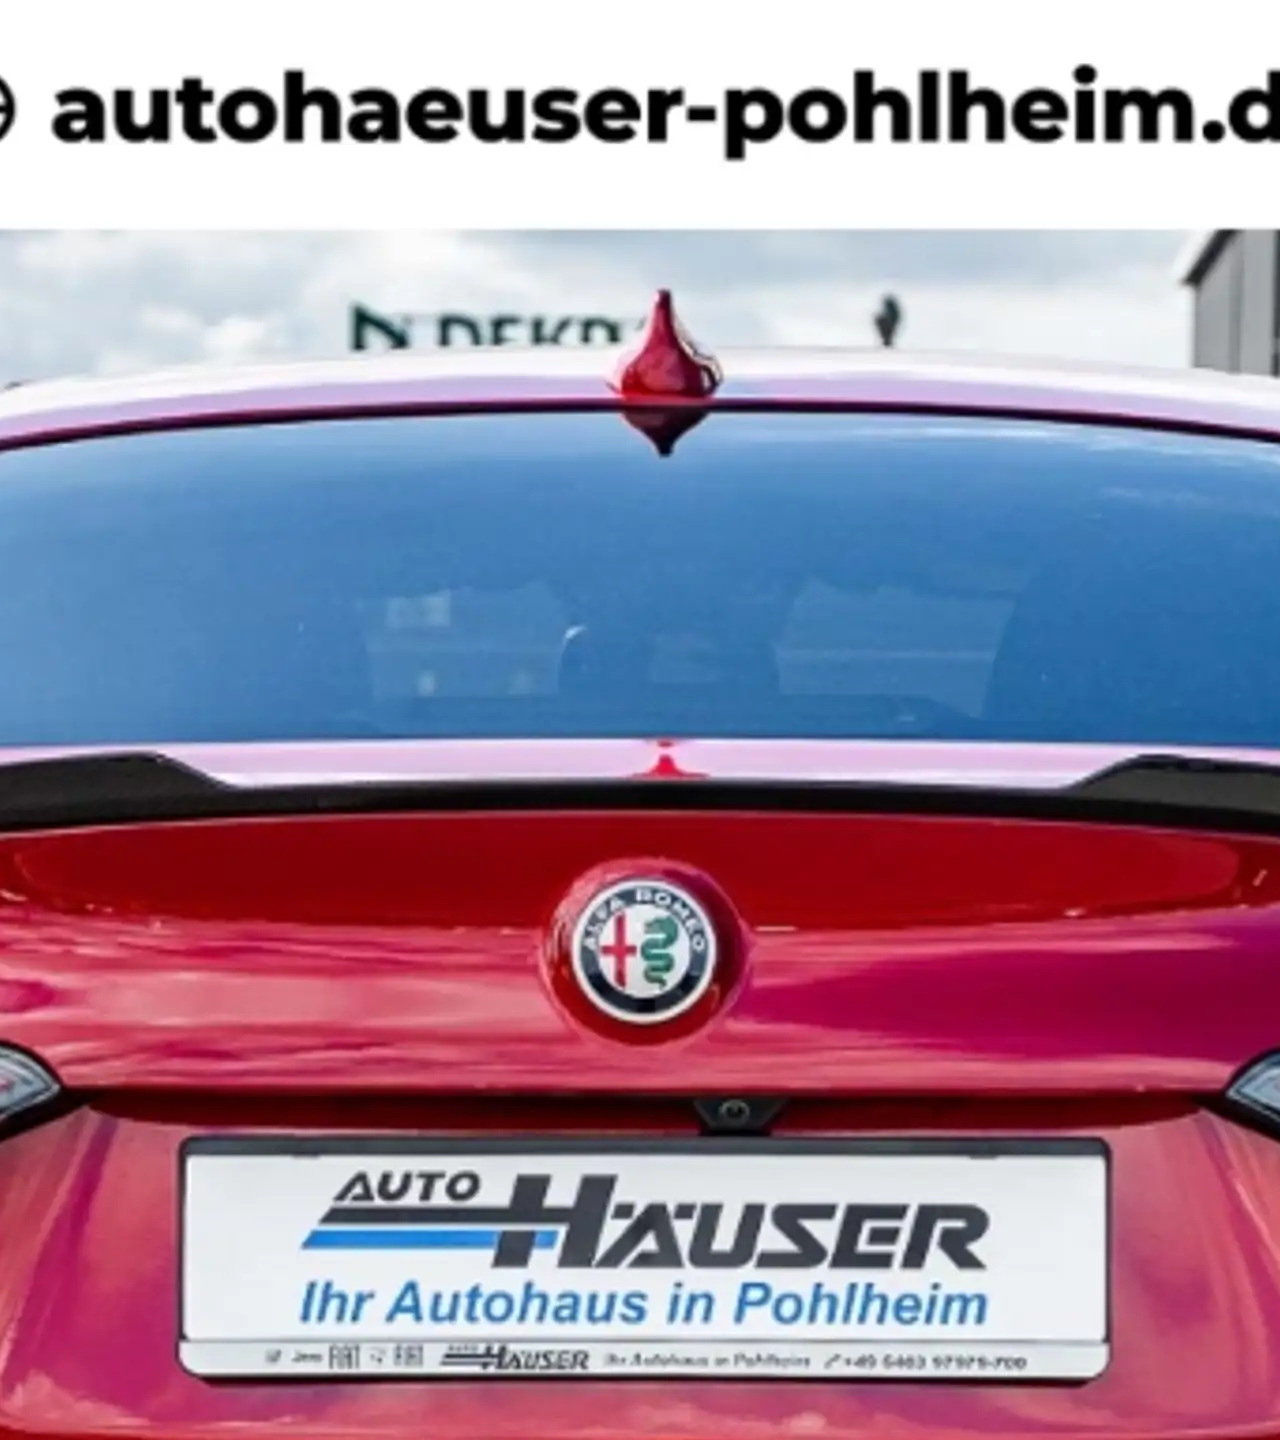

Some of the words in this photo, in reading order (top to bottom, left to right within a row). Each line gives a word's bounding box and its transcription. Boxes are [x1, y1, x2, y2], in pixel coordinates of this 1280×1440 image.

[583, 895, 626, 951] ALFA
[635, 887, 707, 952] ROMEO
[332, 1172, 481, 1202] AUTO
[492, 1173, 990, 1269] HÄUSER
[299, 1280, 374, 1325] Ihr
[385, 1280, 648, 1325] Autohaus
[666, 1280, 714, 1325] in
[732, 1280, 988, 1325] Pohlheim
